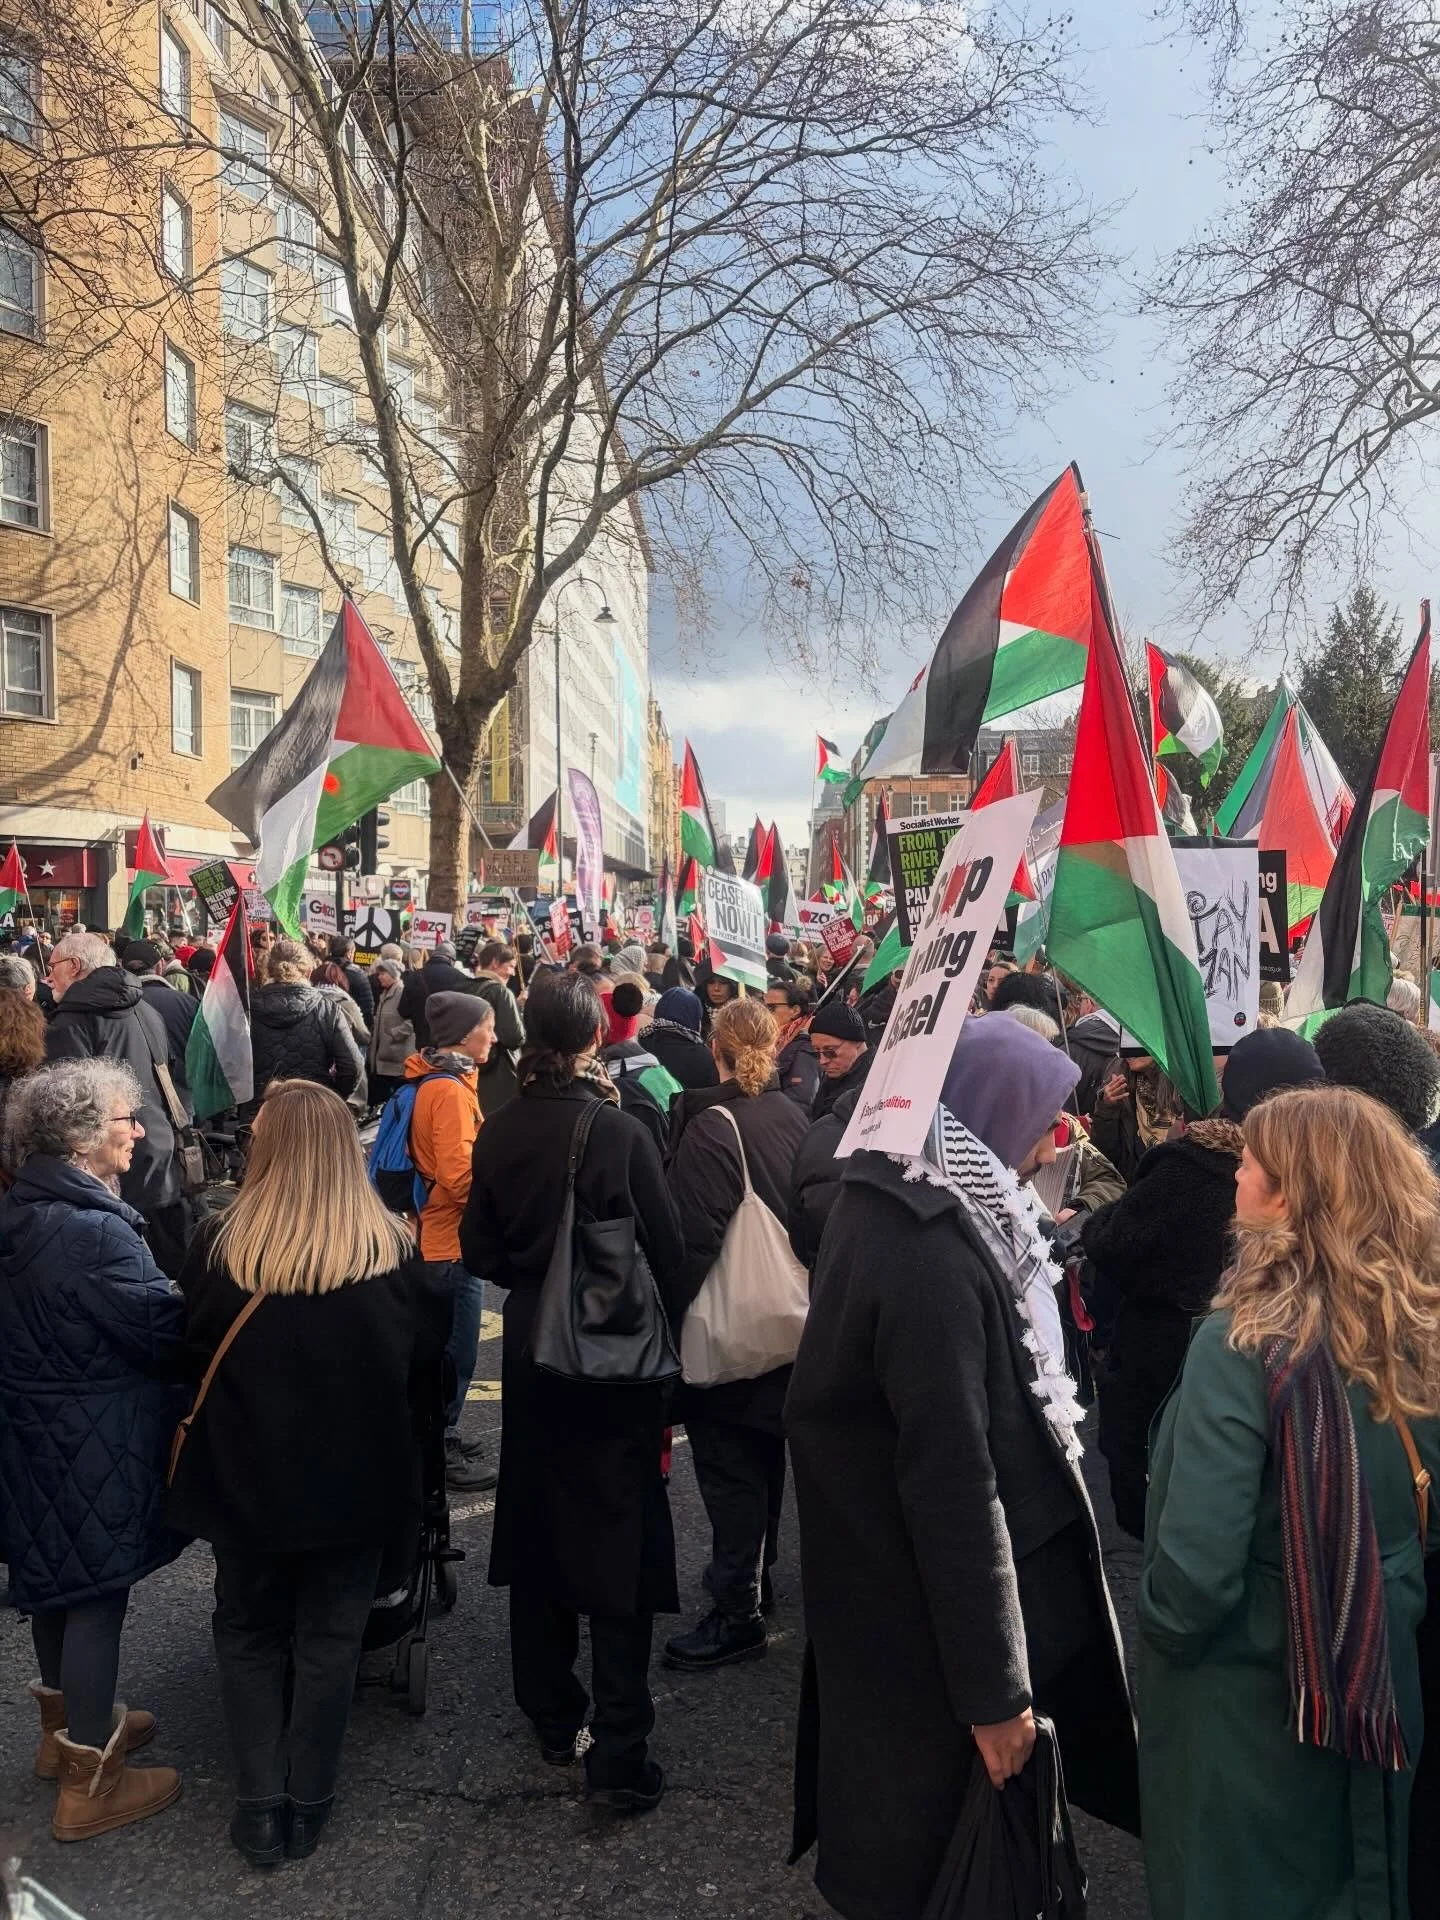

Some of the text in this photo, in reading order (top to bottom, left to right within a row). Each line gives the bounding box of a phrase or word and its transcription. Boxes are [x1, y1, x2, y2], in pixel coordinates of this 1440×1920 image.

[899, 815, 960, 830] Socialist Worker
[898, 831, 936, 852] FROM
[492, 852, 529, 862] FREE
[901, 849, 939, 872] RIVER
[902, 867, 928, 888] THE
[715, 902, 760, 943] NOW!
